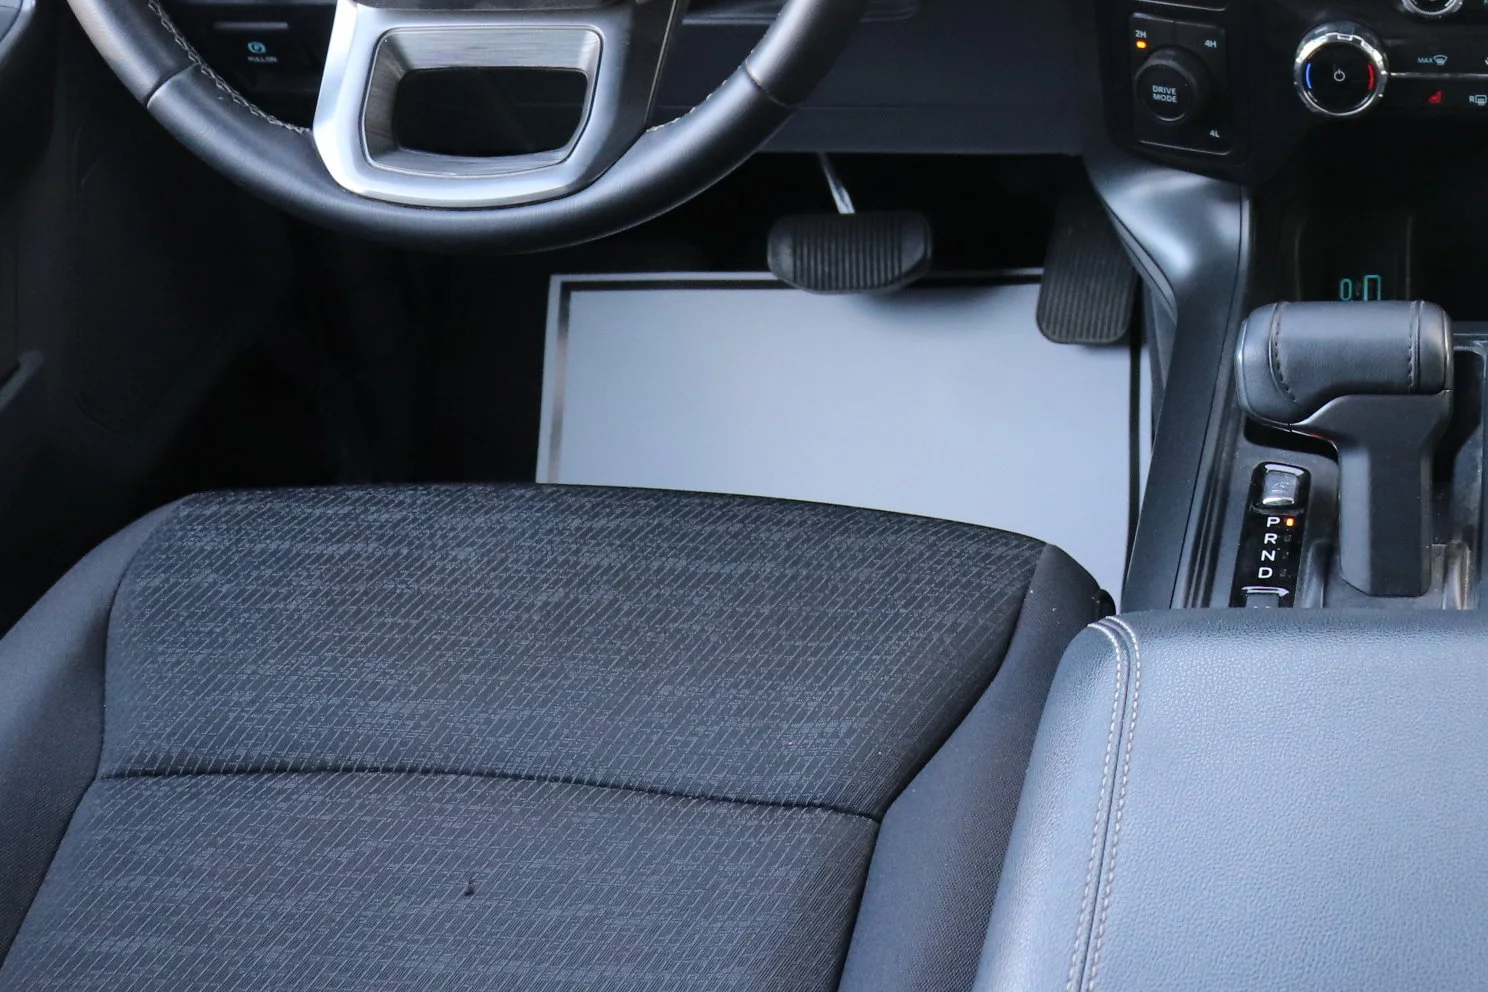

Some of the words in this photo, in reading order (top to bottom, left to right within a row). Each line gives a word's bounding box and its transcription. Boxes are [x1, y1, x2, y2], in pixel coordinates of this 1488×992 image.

[1135, 29, 1147, 39] 2H
[1204, 39, 1217, 49] 4H
[1152, 85, 1177, 95] DRIVE
[1152, 93, 1177, 103] MODE
[1209, 129, 1220, 138] 4L
[1266, 516, 1281, 528] P
[1263, 533, 1278, 545] R
[1260, 549, 1276, 562] N
[1257, 567, 1273, 579] D
